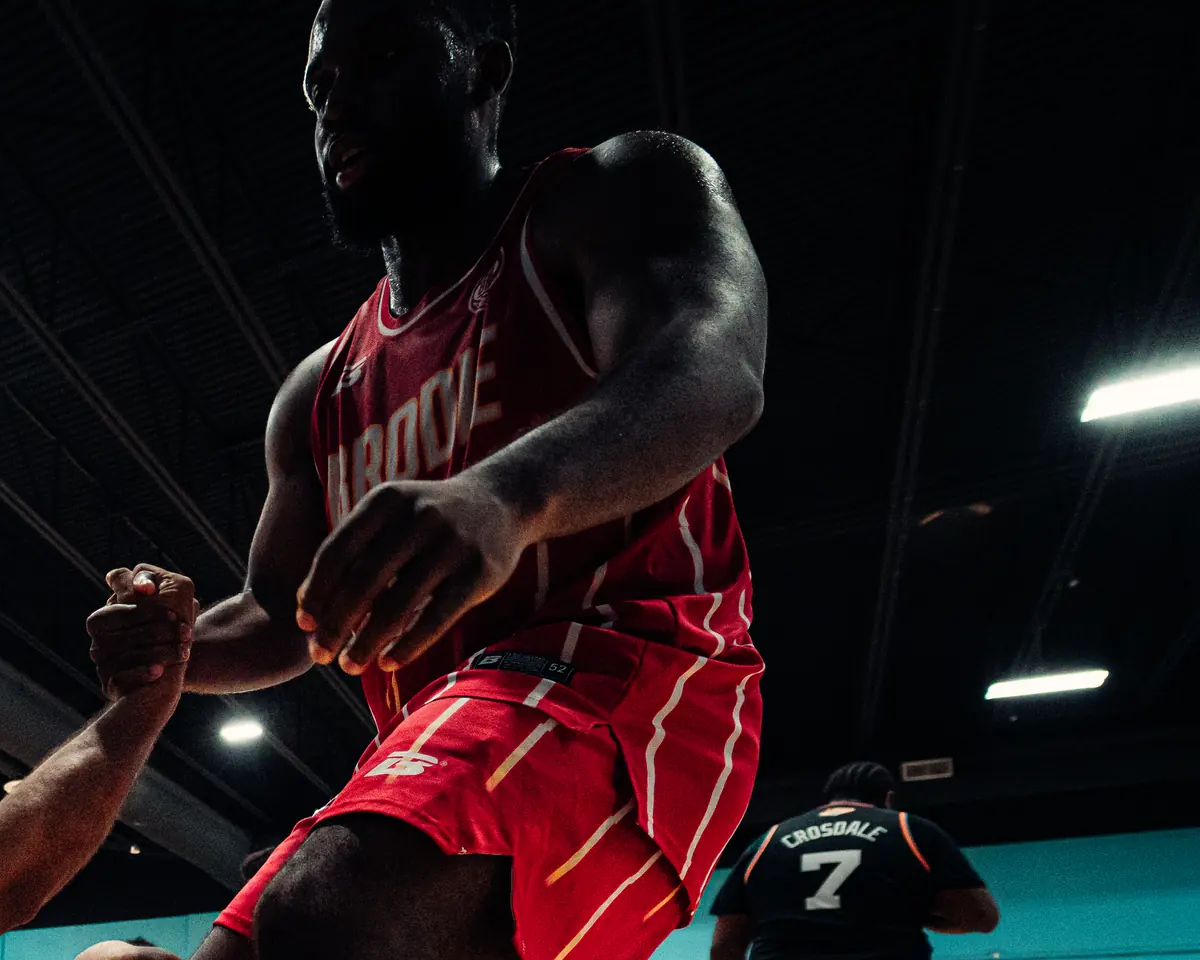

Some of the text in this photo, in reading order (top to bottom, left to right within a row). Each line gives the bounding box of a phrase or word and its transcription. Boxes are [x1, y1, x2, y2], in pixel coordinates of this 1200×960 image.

[548, 662, 567, 674] 52
[780, 820, 889, 849] CROSDALE
[801, 849, 862, 911] 7
